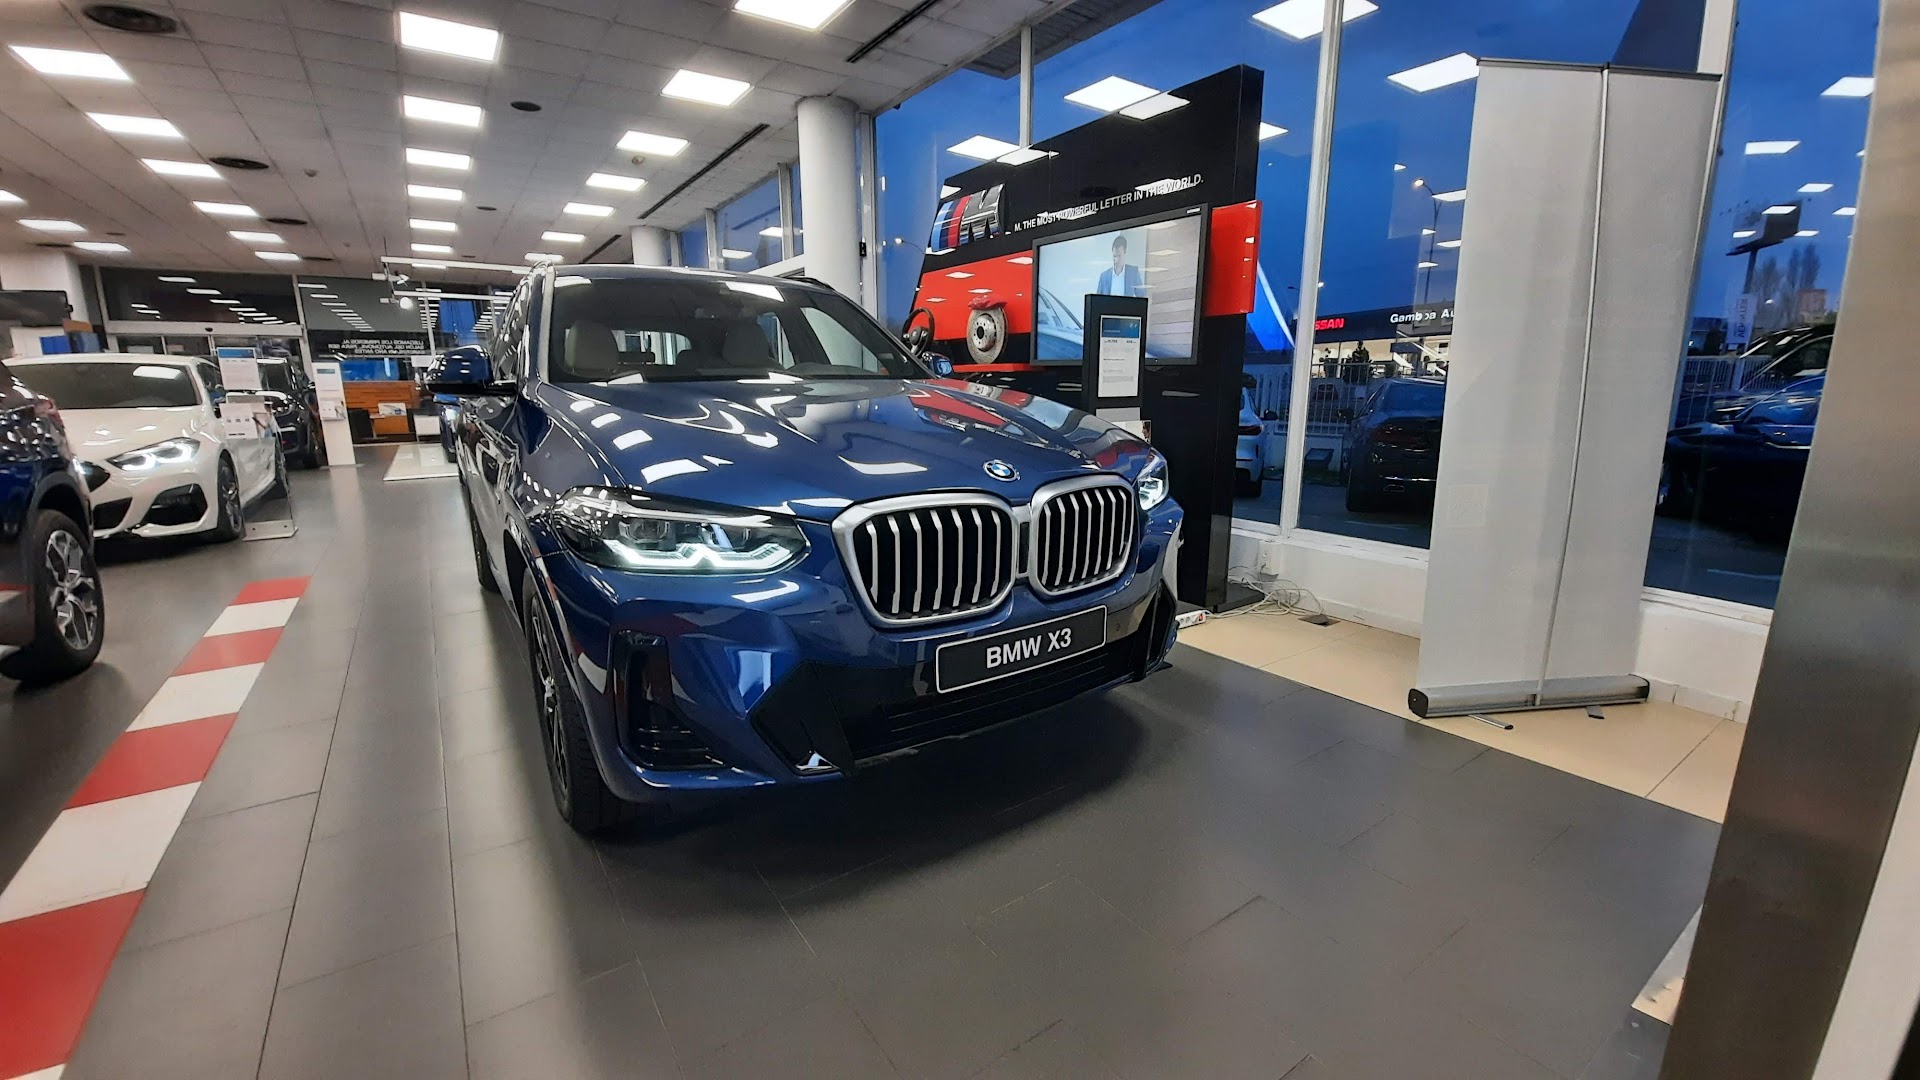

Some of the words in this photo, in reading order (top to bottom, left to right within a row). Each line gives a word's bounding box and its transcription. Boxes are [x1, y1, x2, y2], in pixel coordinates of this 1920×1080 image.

[1014, 222, 1022, 232] M.
[1023, 218, 1036, 230] THE
[1037, 213, 1057, 226] MOST
[1057, 202, 1099, 221] POWERFUL
[1100, 193, 1132, 210] LETTER
[1134, 188, 1143, 201] IN
[1143, 184, 1165, 198] THE
[1166, 174, 1204, 193] WORLD.
[986, 635, 1042, 669] BMW
[1048, 627, 1072, 652] X3
